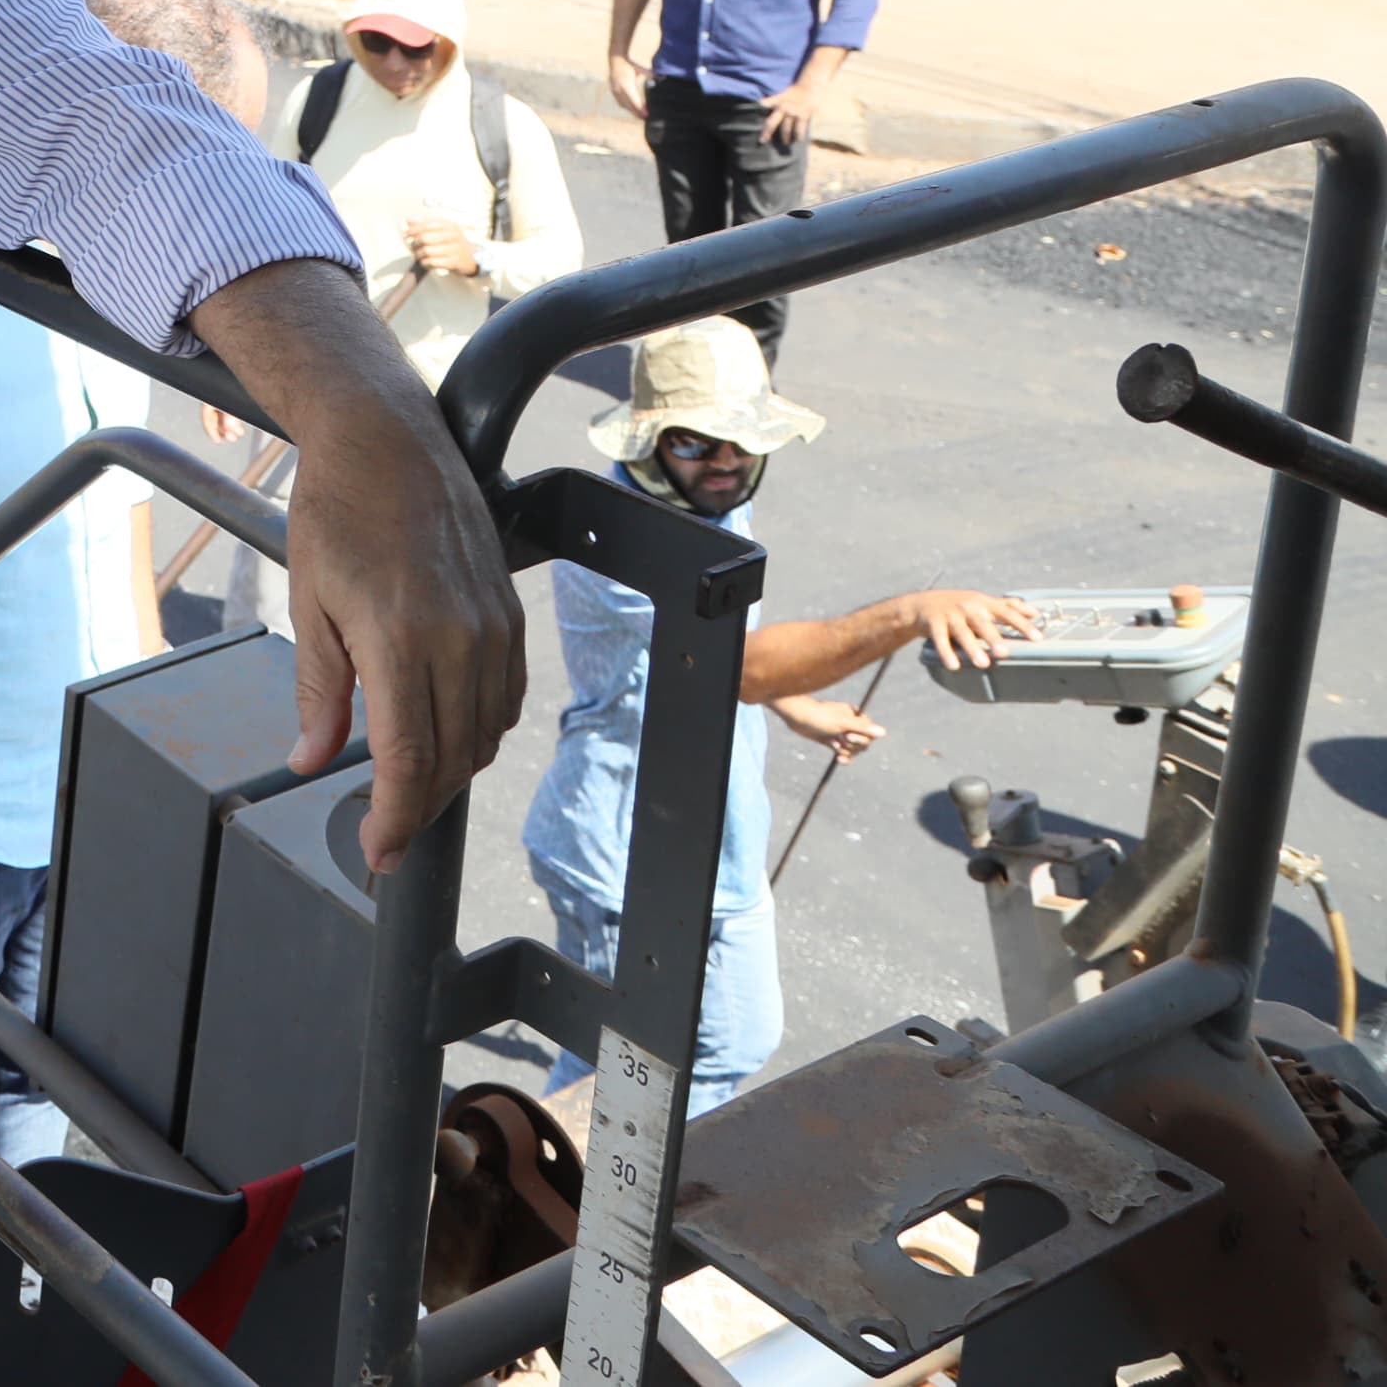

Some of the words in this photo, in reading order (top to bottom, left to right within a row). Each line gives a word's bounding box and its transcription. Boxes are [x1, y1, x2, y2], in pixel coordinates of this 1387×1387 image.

[622, 1054, 650, 1086] 35
[611, 1155, 637, 1186] 30
[598, 1252, 625, 1284] 25
[587, 1347, 613, 1378] 20
